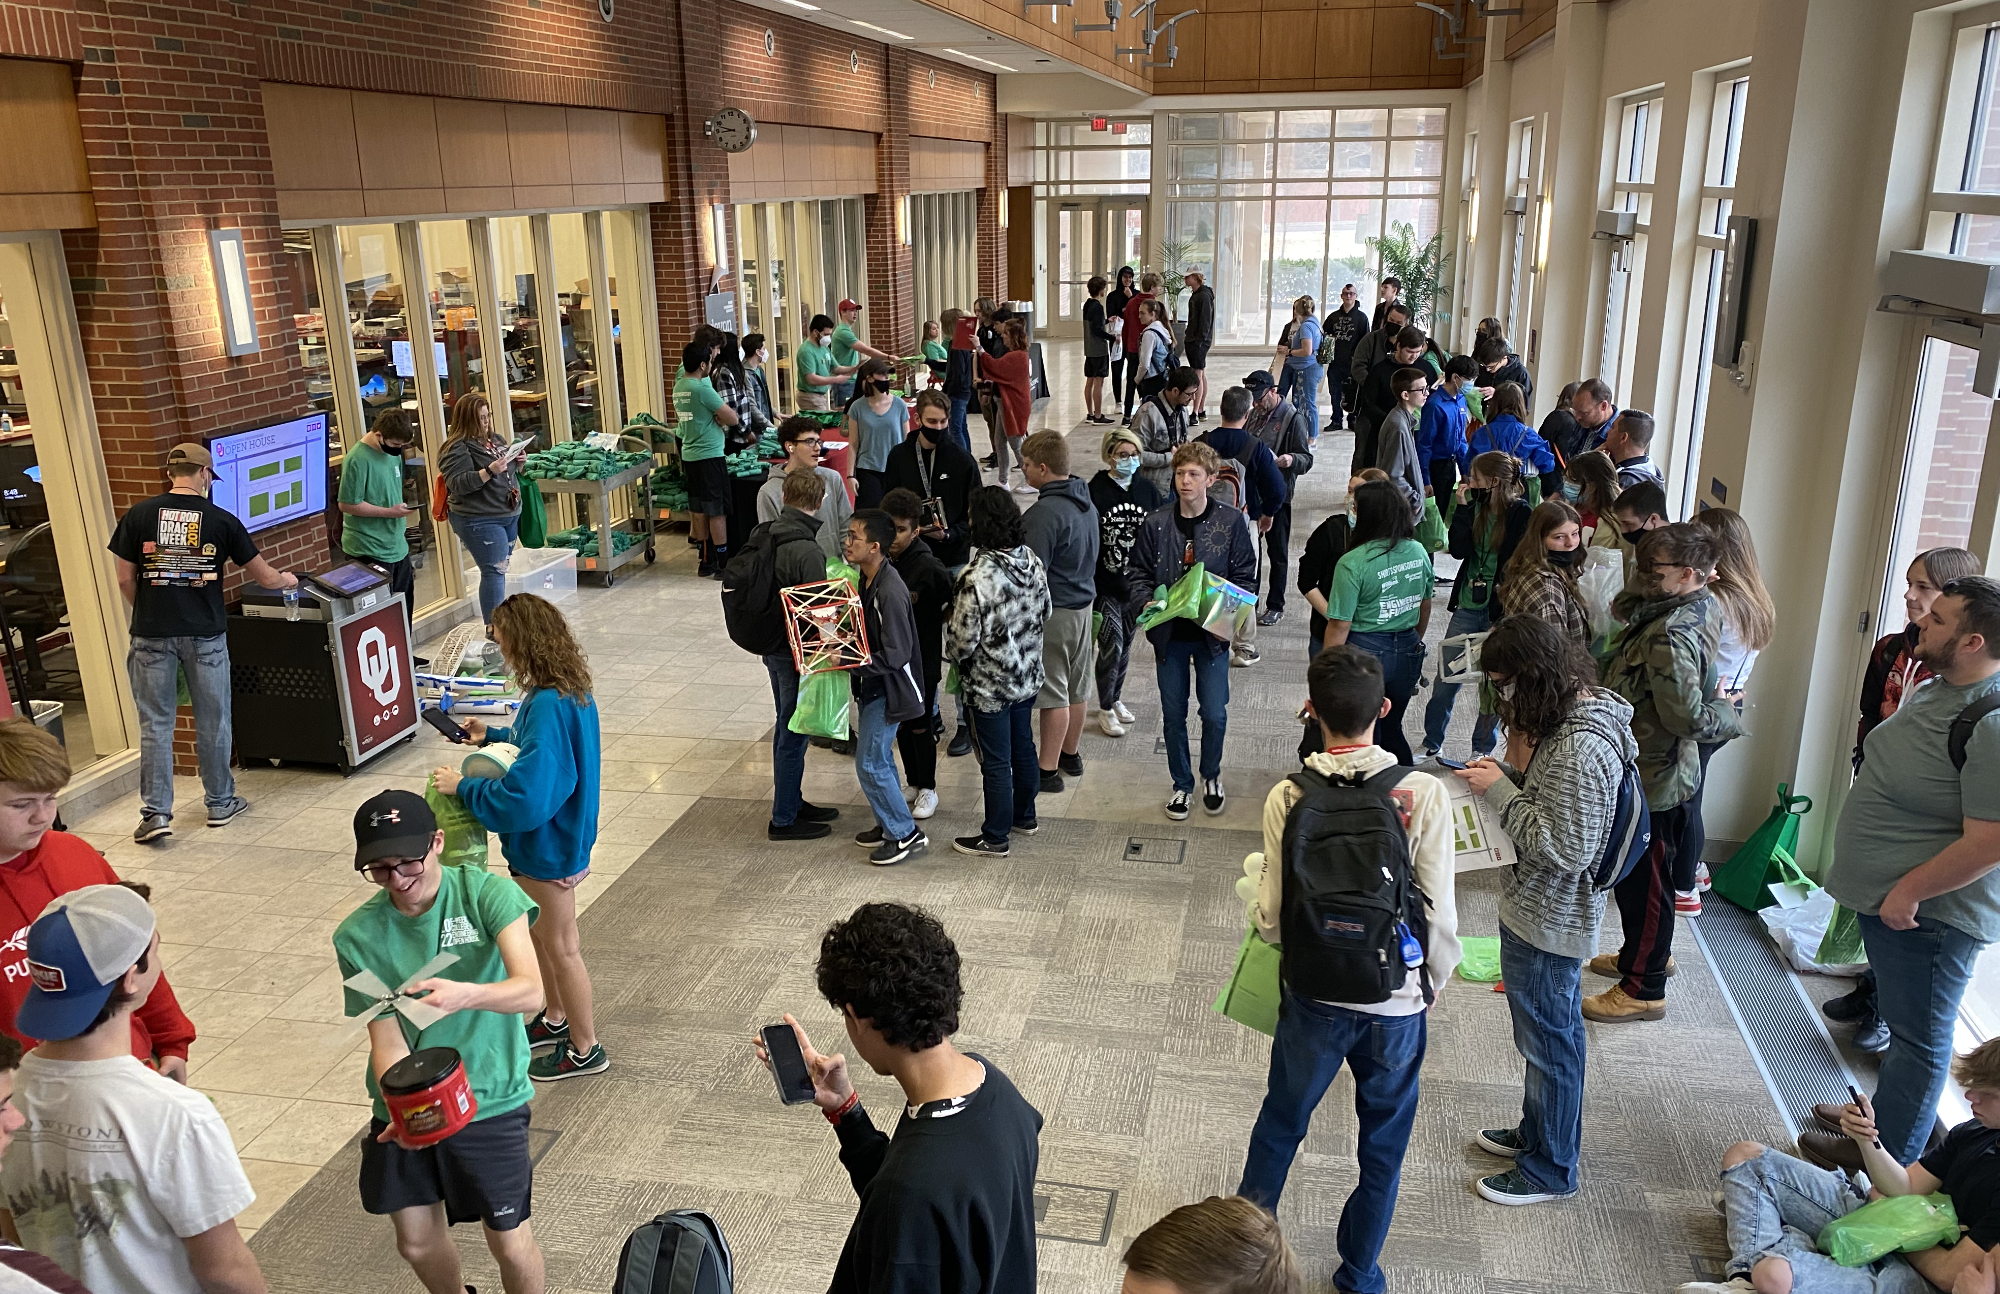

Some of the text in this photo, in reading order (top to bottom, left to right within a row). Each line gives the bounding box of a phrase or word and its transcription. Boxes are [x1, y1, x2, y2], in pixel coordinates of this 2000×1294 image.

[1093, 119, 1106, 130] EXIT
[225, 440, 247, 455] OPEN
[249, 435, 276, 449] HOUSE
[161, 510, 199, 522] HOT ROD
[160, 521, 188, 533] DRAG
[187, 522, 199, 546] 2019
[160, 532, 187, 545] WEEK
[1379, 594, 1421, 610] ENGINEERING
[357, 626, 401, 706] OU
[441, 933, 454, 947] 22
